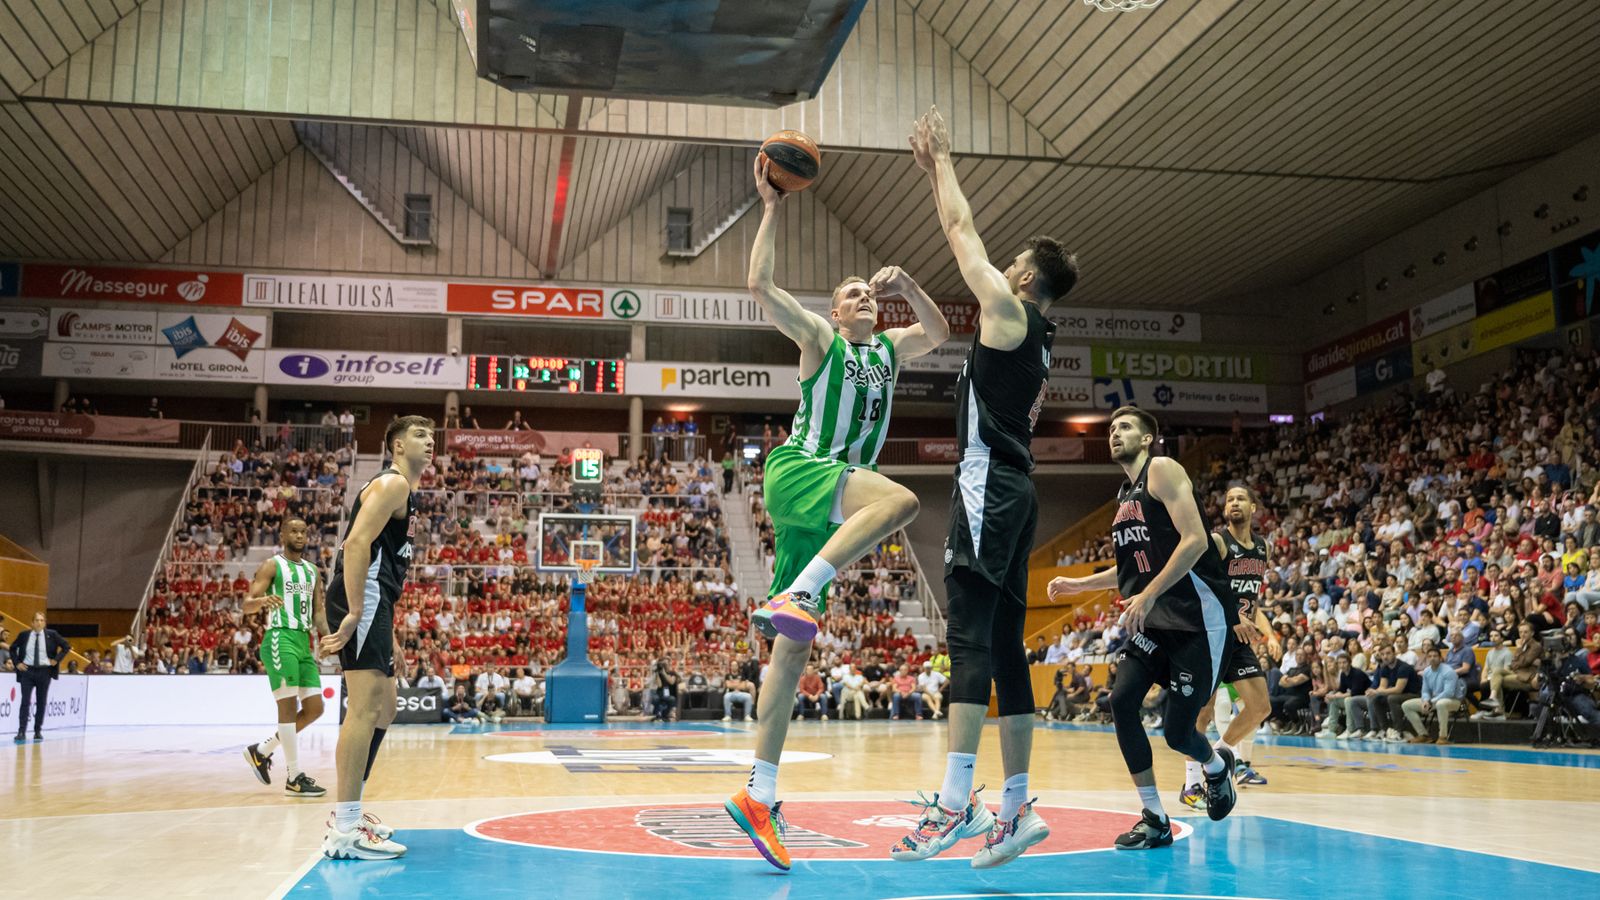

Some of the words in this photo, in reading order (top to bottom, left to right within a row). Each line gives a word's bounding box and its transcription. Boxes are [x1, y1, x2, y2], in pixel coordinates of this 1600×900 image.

[60, 268, 168, 297] Massegur
[278, 281, 328, 306] LLEAL
[337, 283, 393, 308] TULSÀ
[491, 289, 602, 312] SPAR
[684, 298, 730, 321] LLEAL
[74, 322, 111, 332] CAMPS
[115, 324, 152, 333] MOTOR
[172, 326, 194, 342] ibis
[226, 327, 251, 349] ibis
[170, 363, 205, 372] HOTEL
[208, 364, 249, 374] GIRONA
[336, 354, 445, 376] infoself
[334, 374, 375, 385] group
[681, 366, 770, 391] parlem
[858, 396, 882, 422] 18
[455, 433, 486, 445] girona
[488, 432, 502, 443] ets
[504, 433, 515, 444] tu
[582, 459, 599, 477] 15
[1133, 550, 1151, 574] 11
[300, 600, 308, 615] 8
